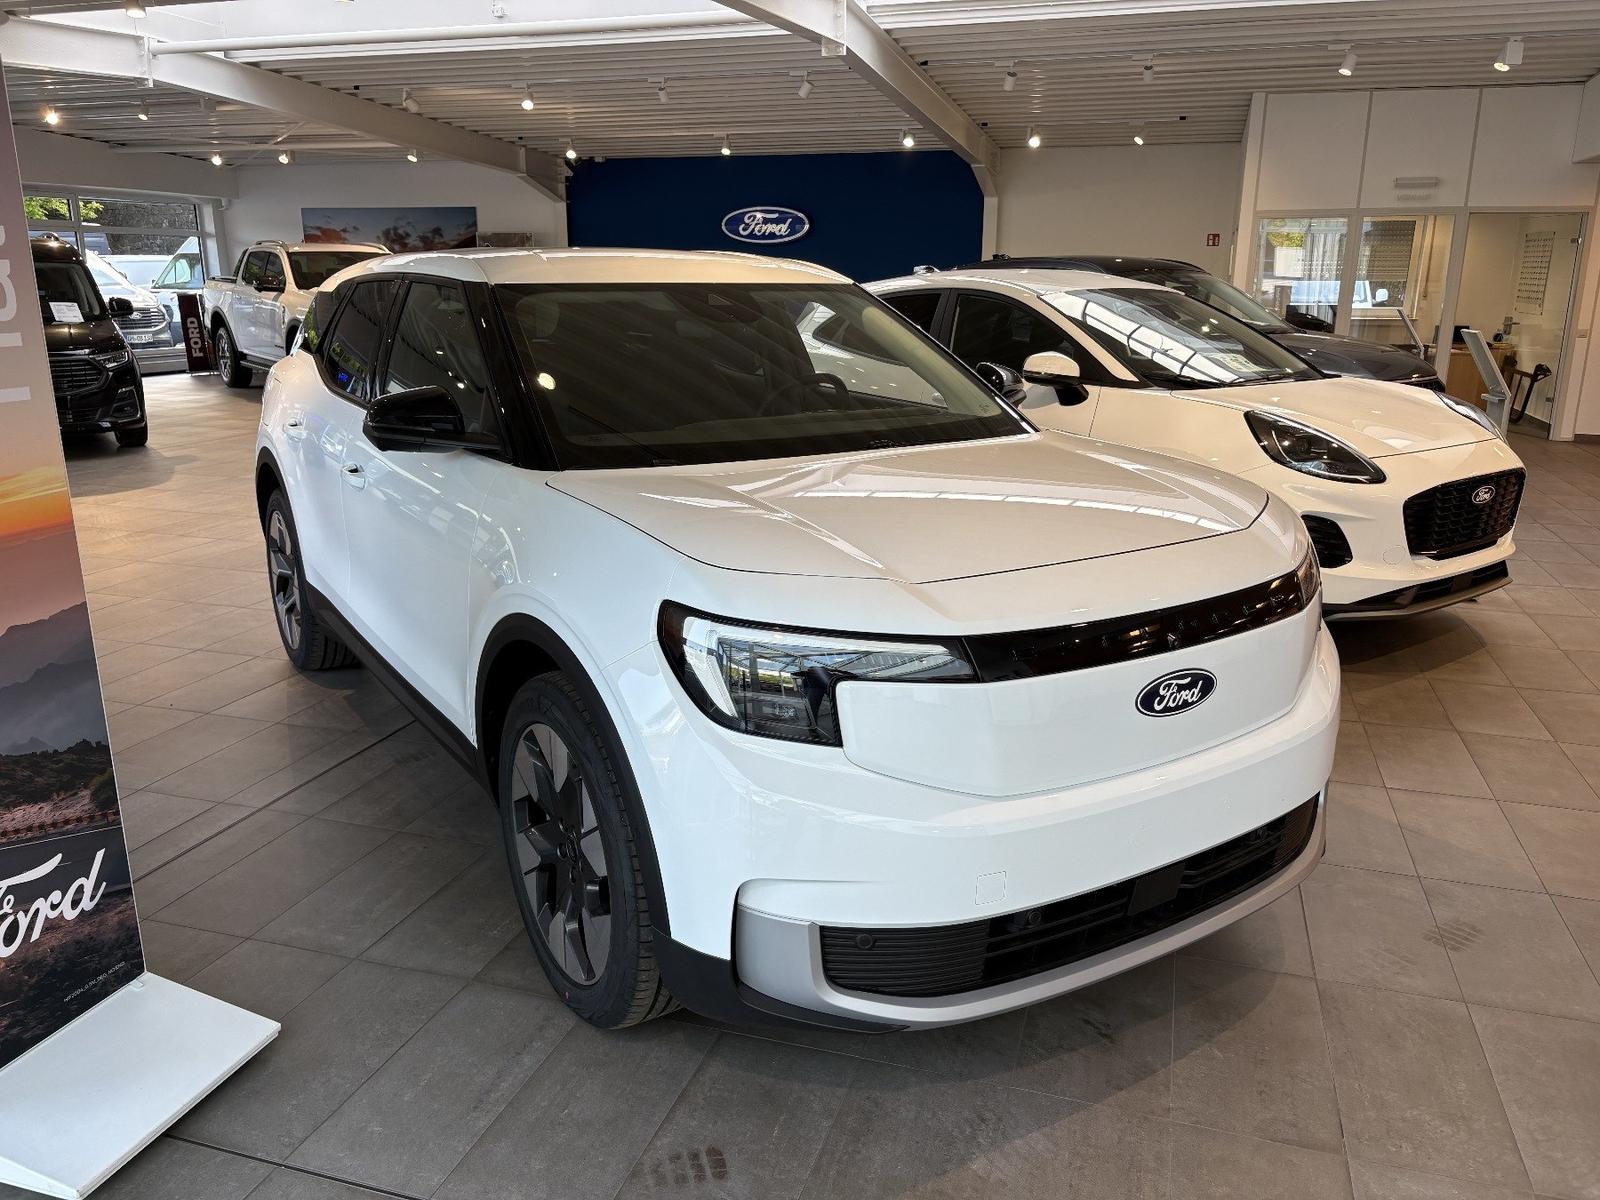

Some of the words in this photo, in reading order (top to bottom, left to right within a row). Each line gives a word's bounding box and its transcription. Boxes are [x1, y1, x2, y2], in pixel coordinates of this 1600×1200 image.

[739, 212, 792, 236] Ford
[186, 317, 204, 358] FORD
[1476, 489, 1491, 501] Ford
[1154, 677, 1203, 711] Ford
